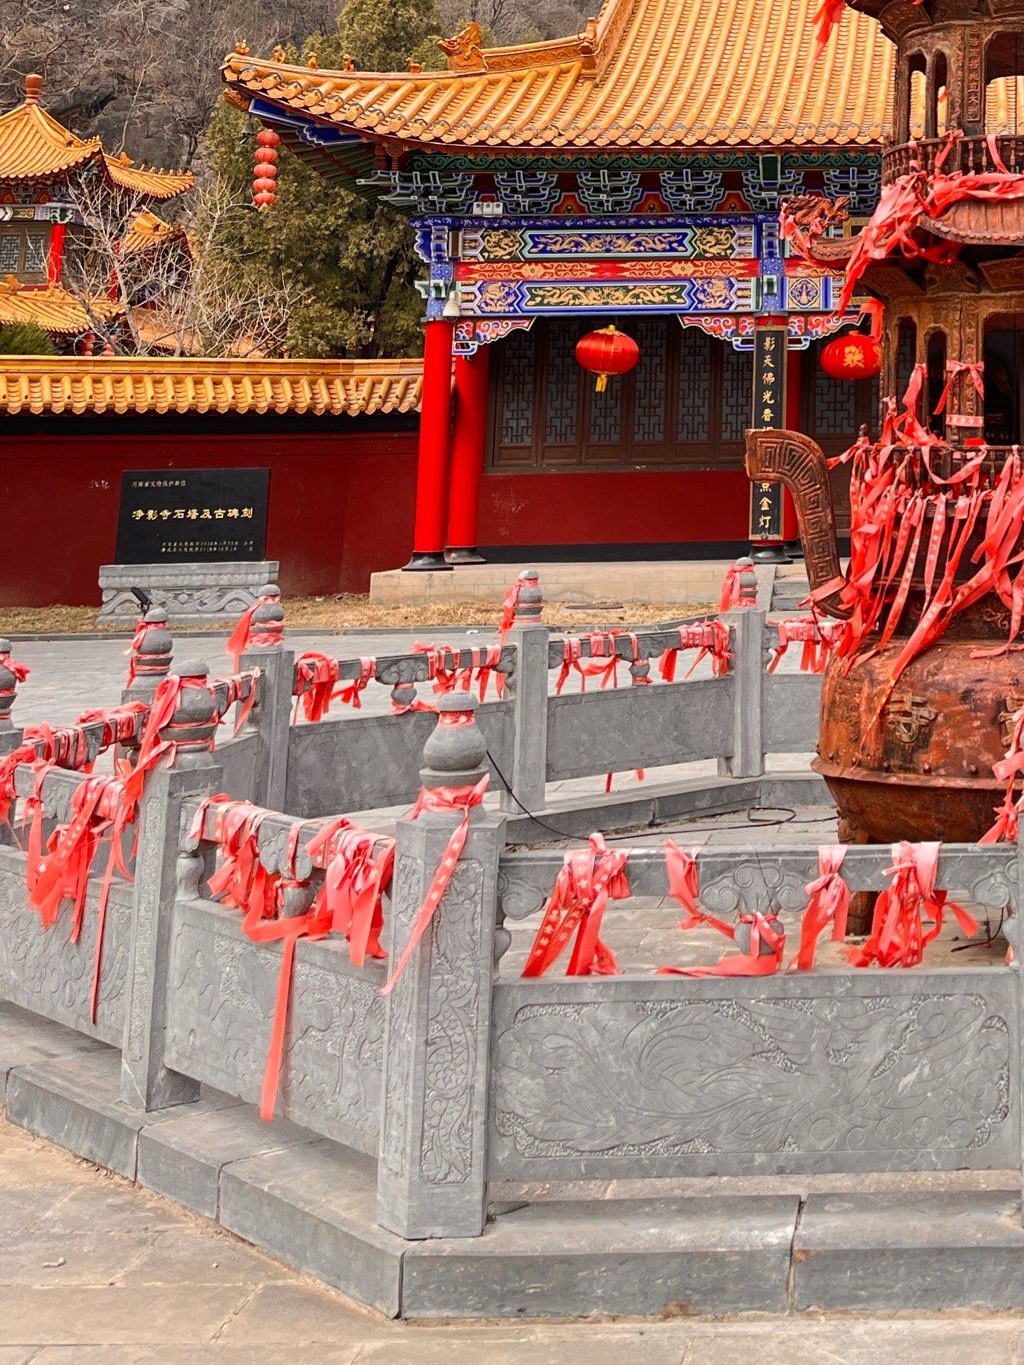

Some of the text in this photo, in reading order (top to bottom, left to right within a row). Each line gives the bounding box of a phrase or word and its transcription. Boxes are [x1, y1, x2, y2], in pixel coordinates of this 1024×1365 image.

[757, 336, 776, 528] 影天佛光香点金灯
